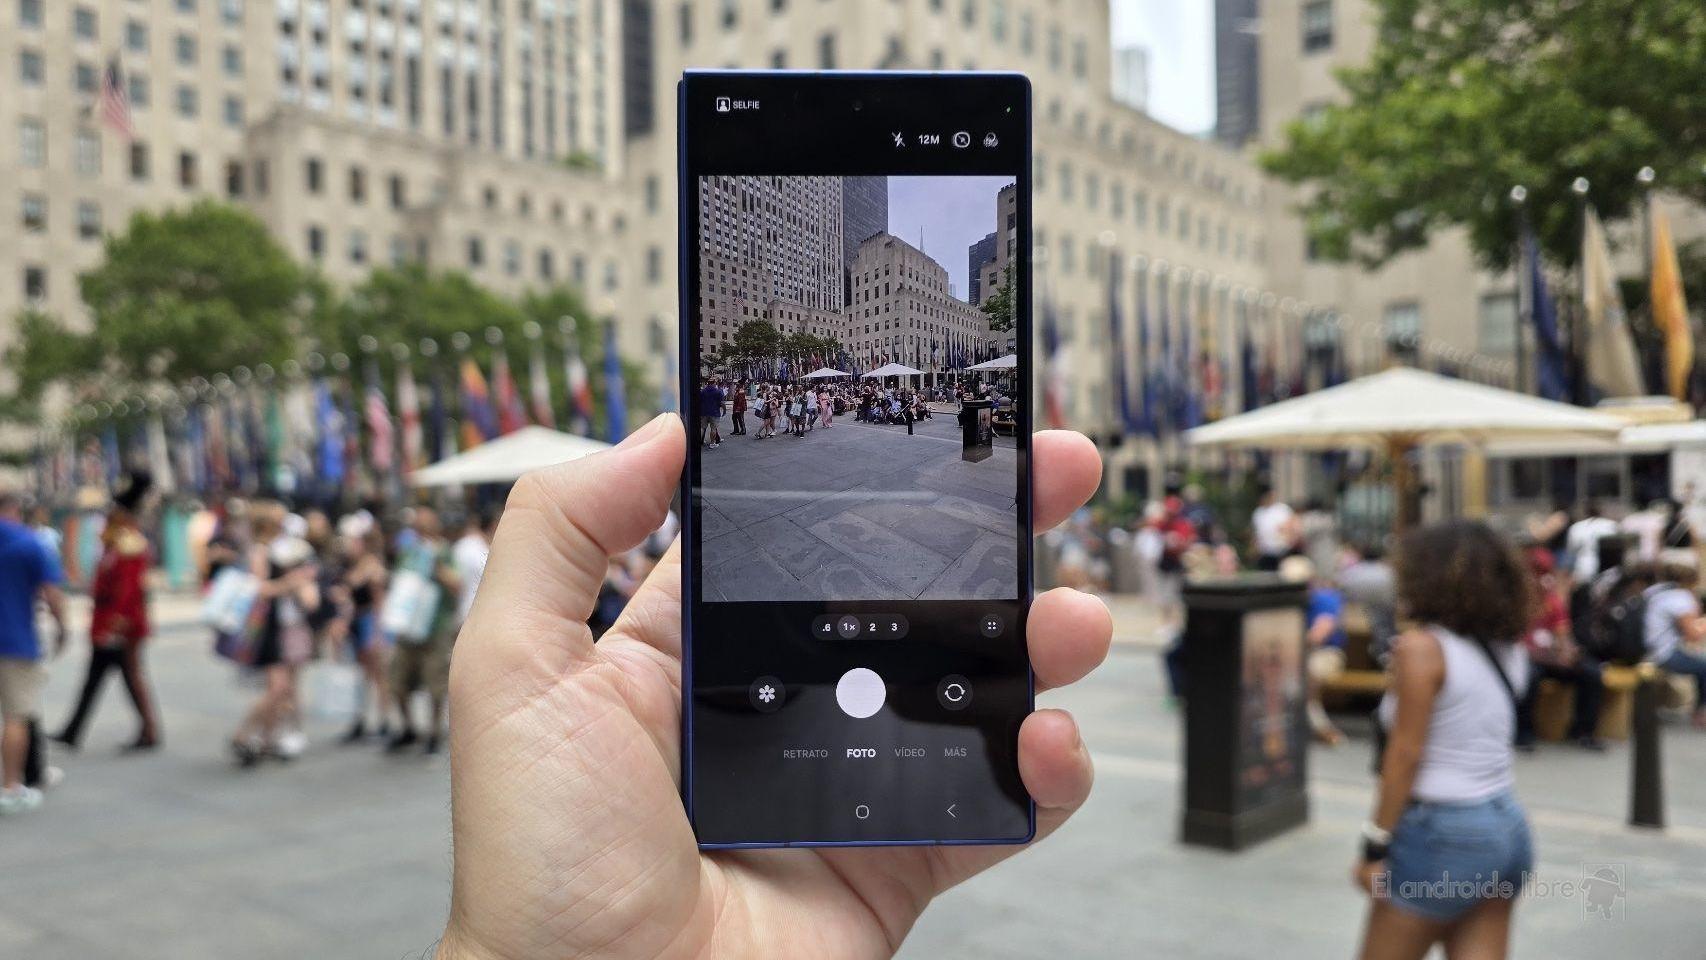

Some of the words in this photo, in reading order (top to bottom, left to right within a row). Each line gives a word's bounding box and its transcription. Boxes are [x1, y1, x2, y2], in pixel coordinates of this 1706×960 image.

[732, 100, 760, 110] SELFIE
[918, 134, 940, 145] 12M
[869, 623, 876, 632] 2
[891, 623, 898, 632] 3
[783, 749, 828, 759] RETRATO
[846, 748, 876, 758] FOTO
[894, 746, 926, 758] VÍDEO
[944, 746, 967, 758] MÁS
